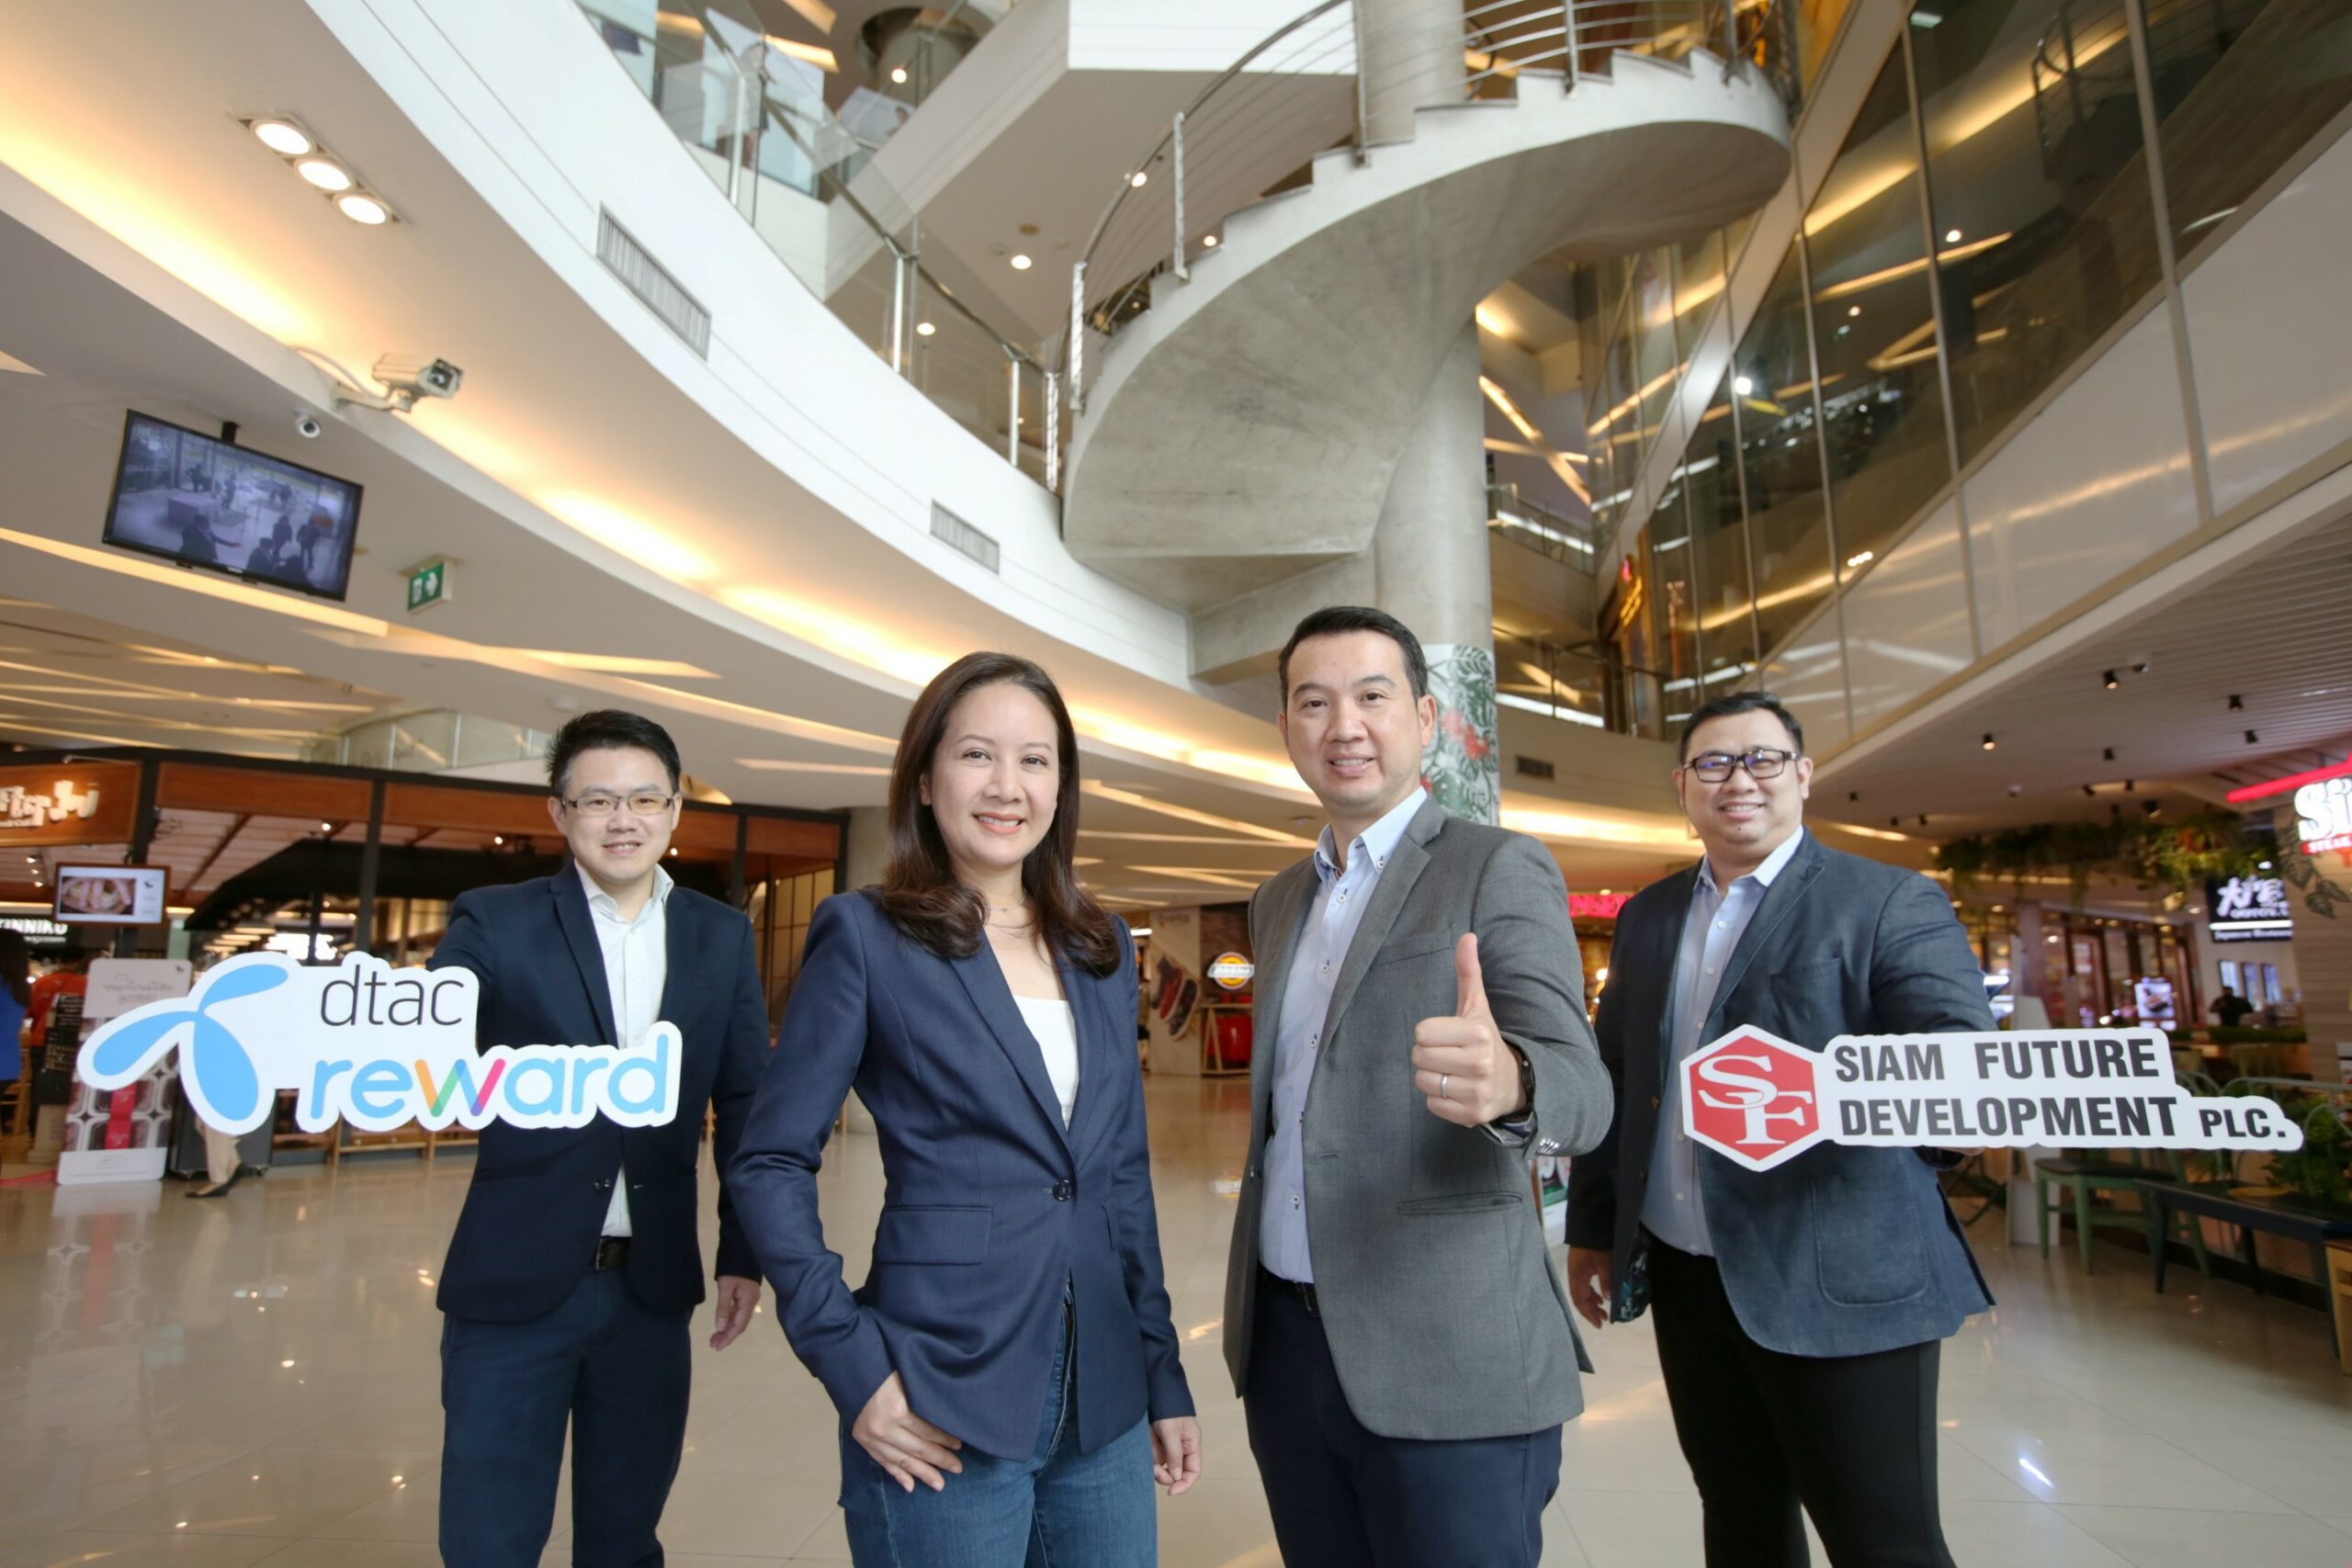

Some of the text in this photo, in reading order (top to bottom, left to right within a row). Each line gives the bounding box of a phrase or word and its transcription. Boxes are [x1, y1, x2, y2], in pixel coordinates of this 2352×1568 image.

[2294, 778, 2352, 841] Si
[321, 964, 465, 1026] dtac
[311, 1034, 669, 1119] reward
[1835, 1038, 2159, 1083] SIAM FUTURE
[1839, 1096, 2287, 1139] DEVELOPMENT PLC.
